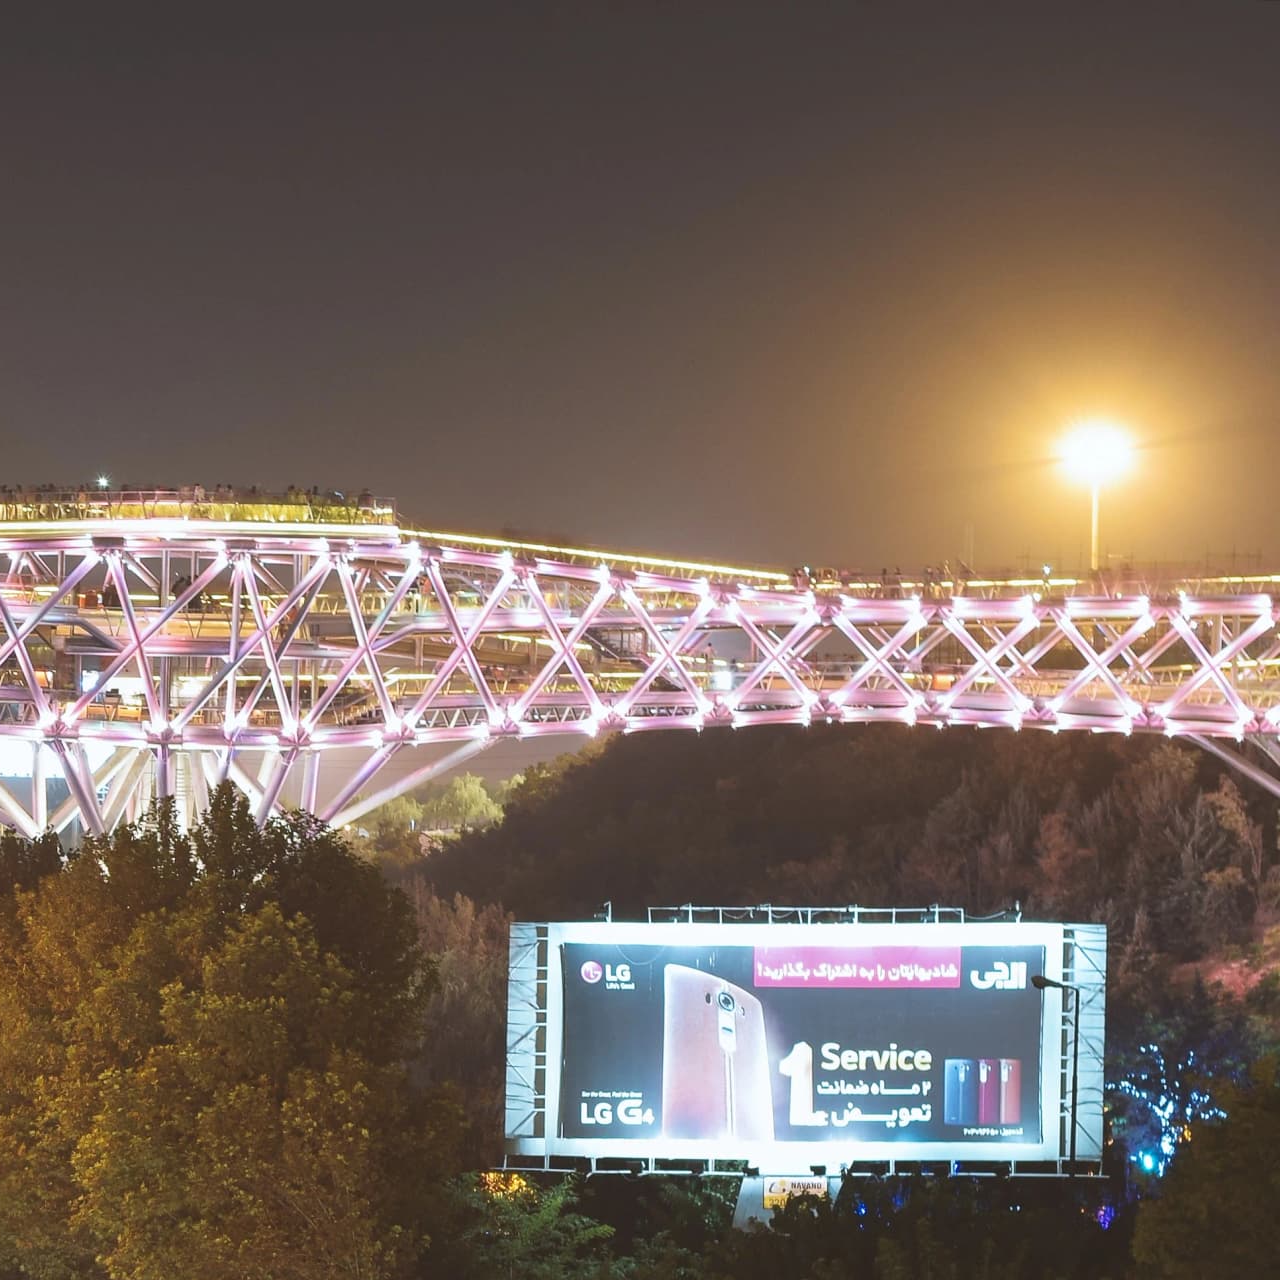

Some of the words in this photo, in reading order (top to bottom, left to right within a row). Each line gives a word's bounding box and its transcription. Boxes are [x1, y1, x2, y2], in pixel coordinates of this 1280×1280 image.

[605, 963, 631, 982] LG
[812, 962, 857, 982] اشتراک
[820, 1042, 933, 1072] Service
[816, 1079, 870, 1096] ضمانت
[870, 1079, 921, 1096] ماه
[580, 1102, 613, 1125] LG
[617, 1099, 656, 1126] G4
[830, 1101, 933, 1129] تعویض
